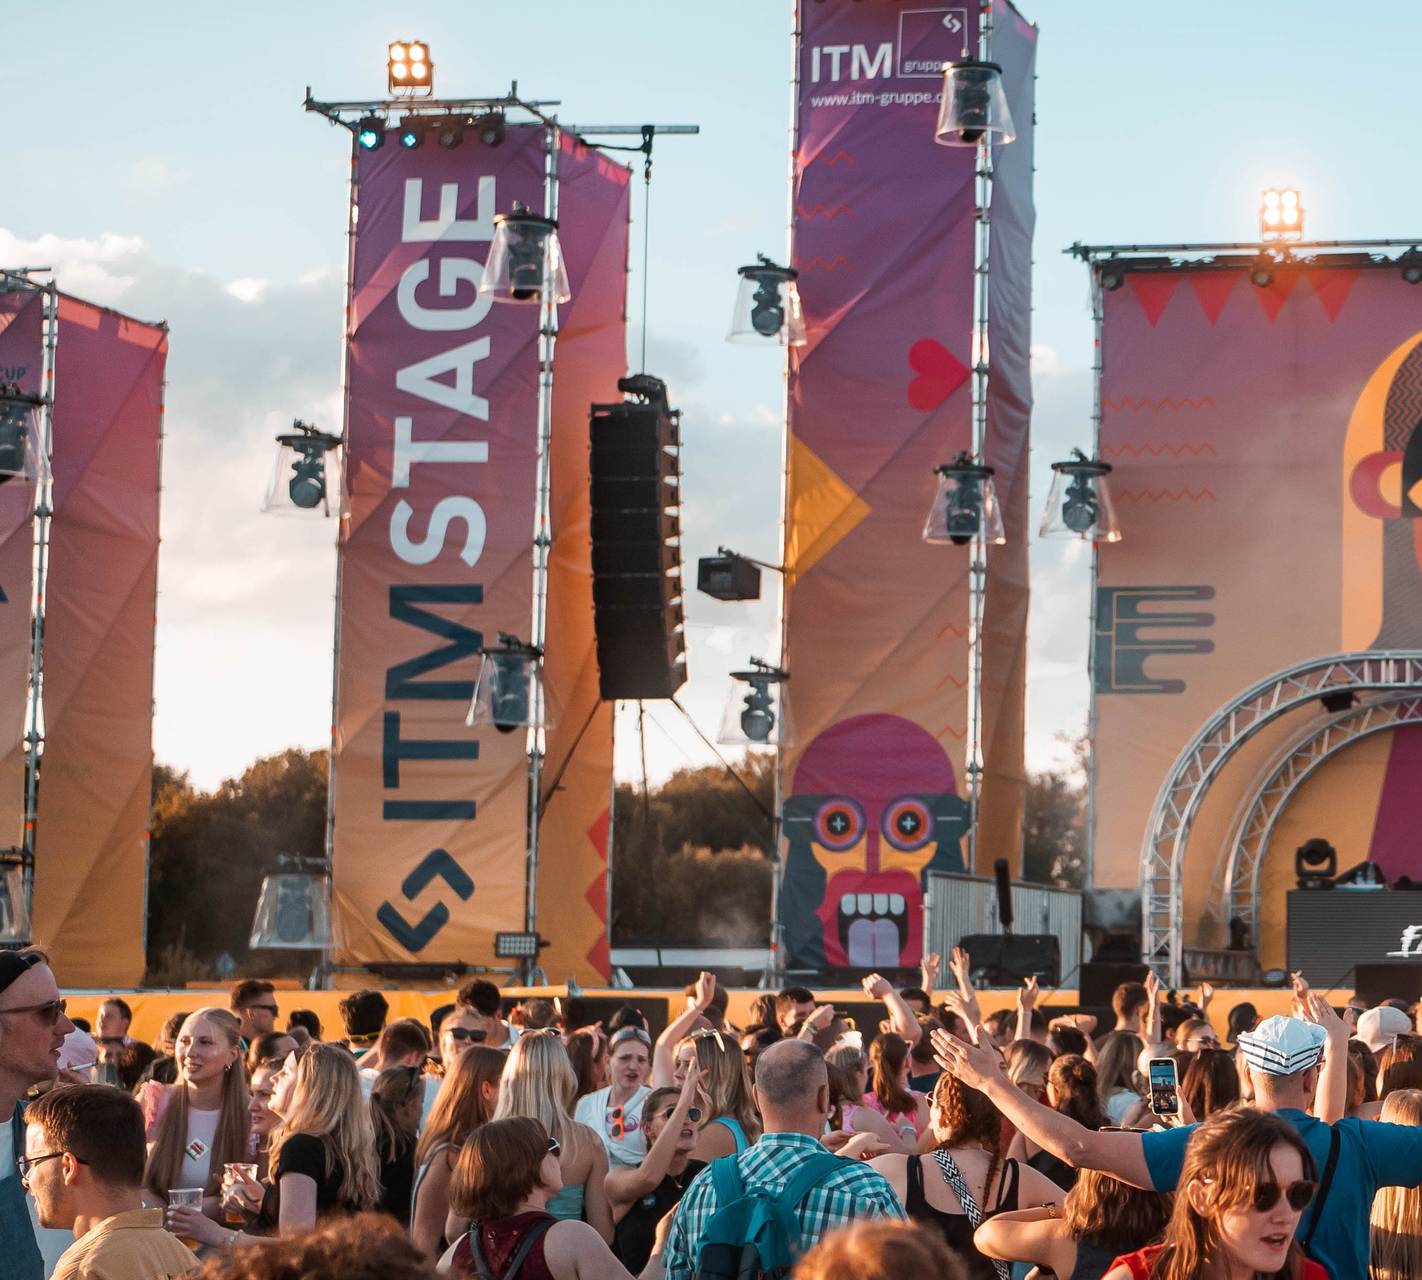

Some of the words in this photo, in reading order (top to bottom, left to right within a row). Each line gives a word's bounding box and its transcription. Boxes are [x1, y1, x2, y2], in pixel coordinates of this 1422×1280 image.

[811, 42, 893, 83] ITM
[905, 60, 943, 73] grupp
[811, 89, 943, 108] www.itm-gruppe.c
